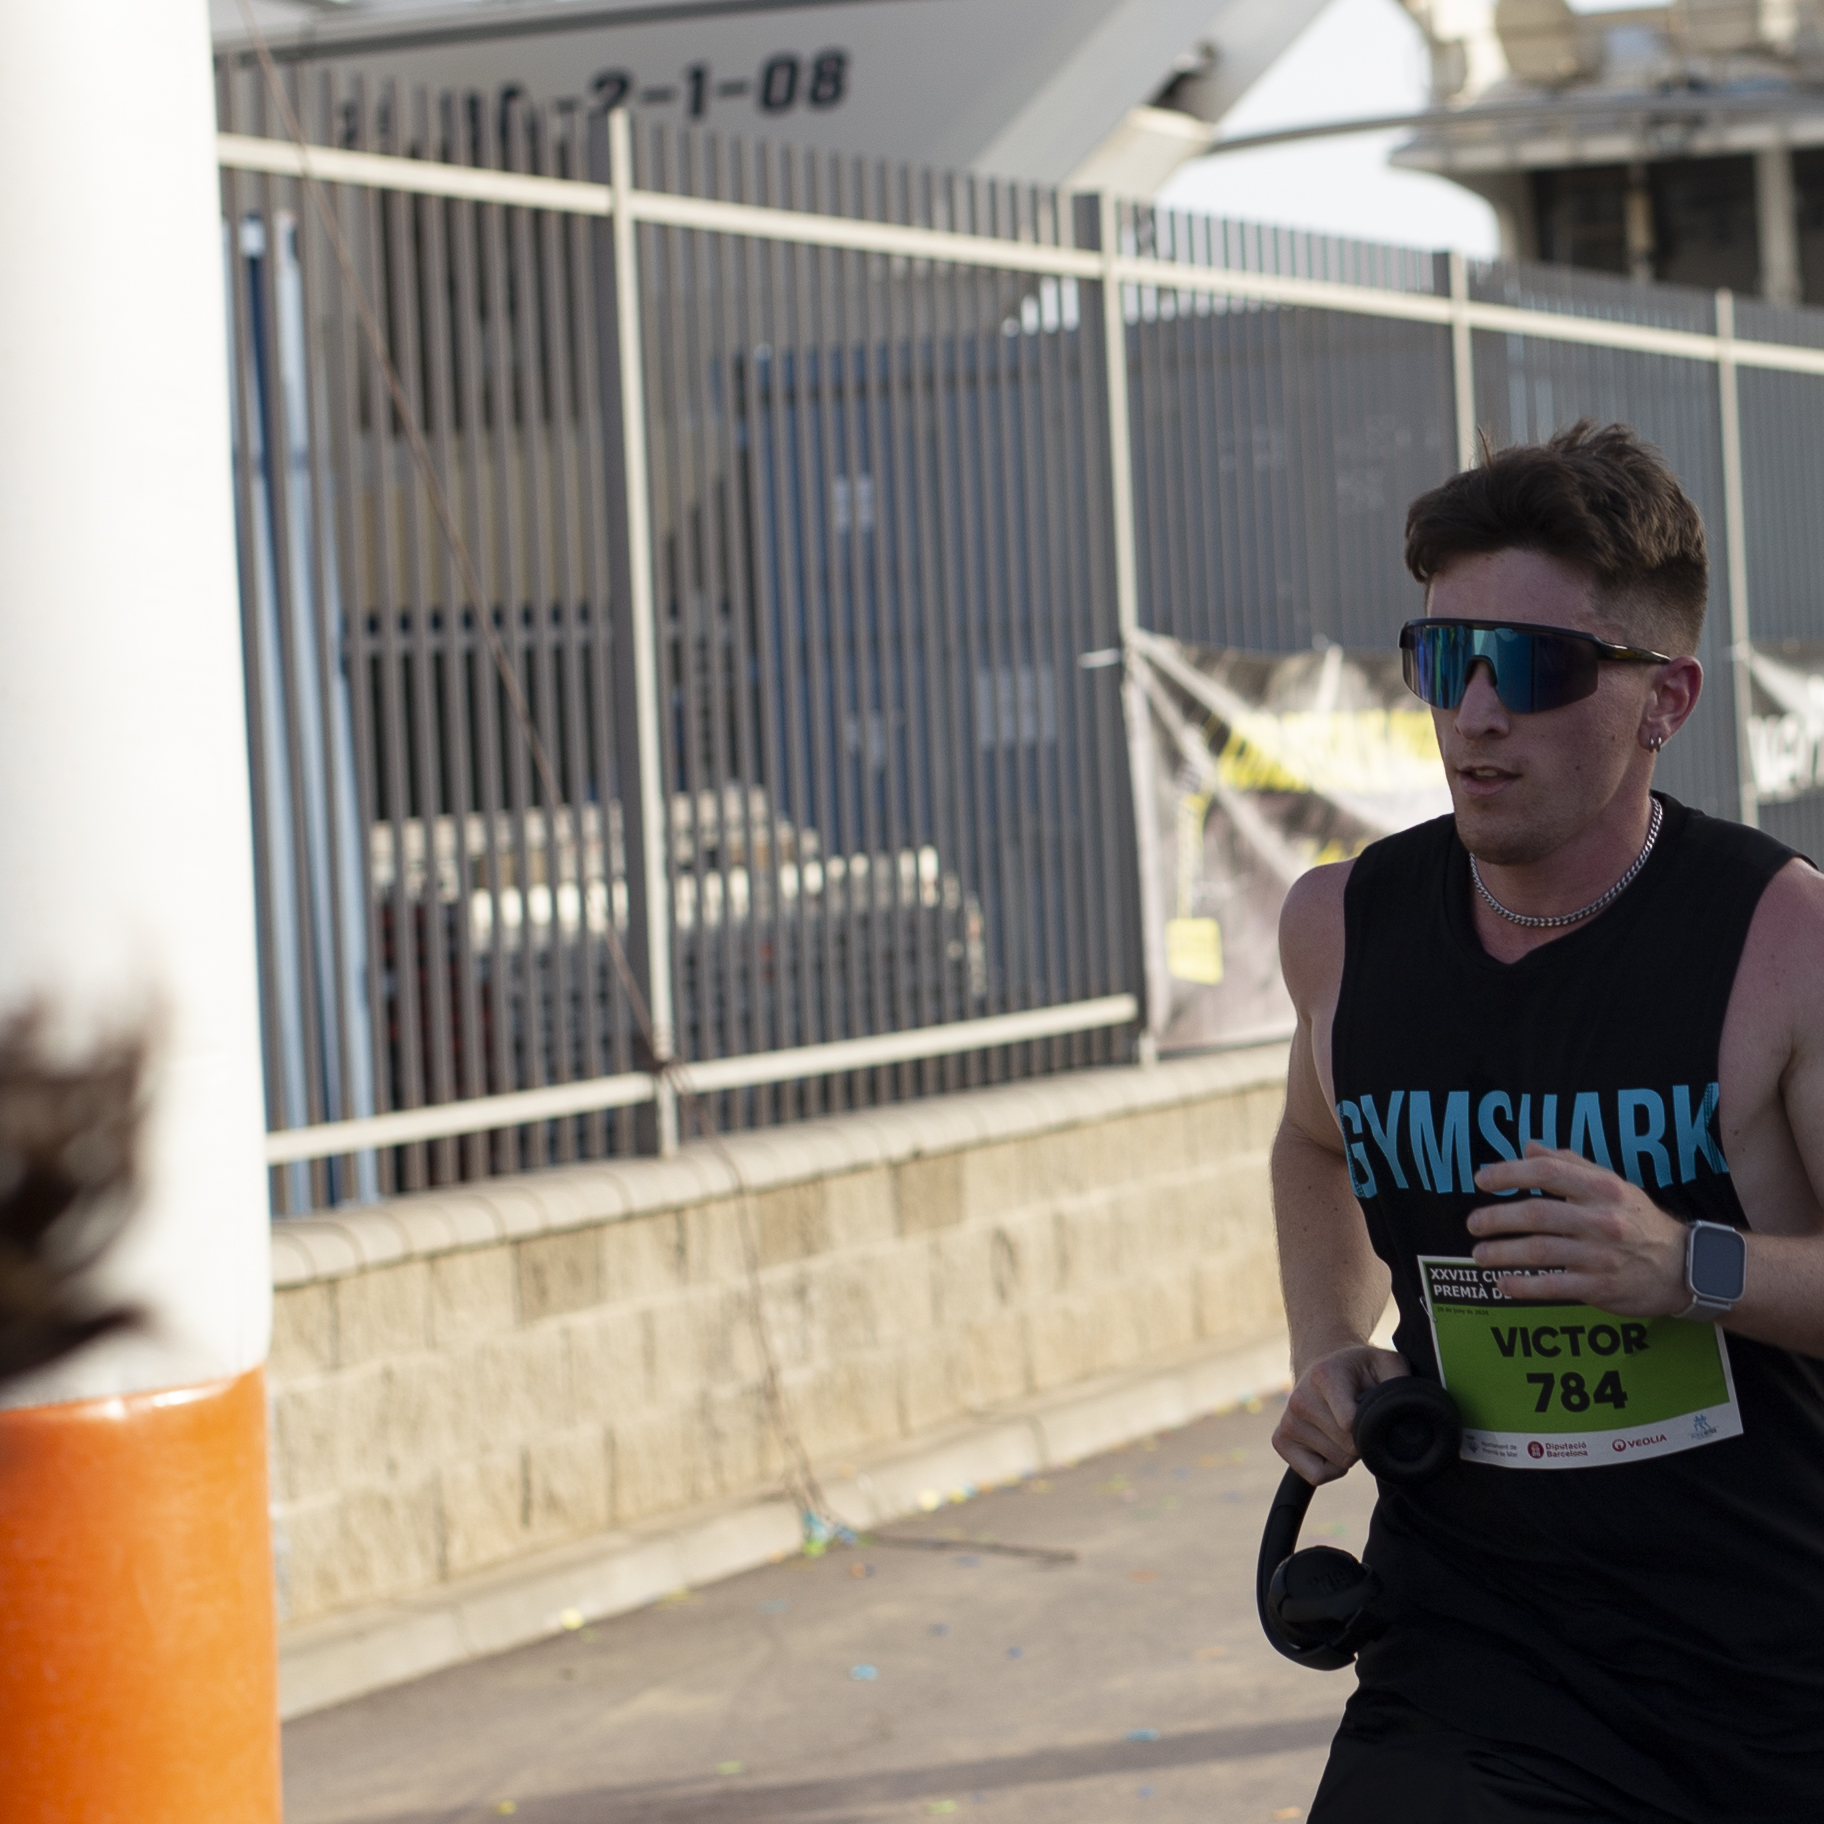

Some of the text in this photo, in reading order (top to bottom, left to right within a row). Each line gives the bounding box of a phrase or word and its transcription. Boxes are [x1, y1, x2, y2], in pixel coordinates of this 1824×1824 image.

[1335, 1081, 1730, 1199] GYMSHARK
[1429, 1267, 1479, 1283] XXVIII
[1433, 1283, 1489, 1300] PREMIÀ
[1490, 1322, 1651, 1358] VICTOR
[1525, 1370, 1629, 1413] 784
[1545, 1441, 1587, 1451] Diputació
[1627, 1434, 1668, 1448] VEOLIA
